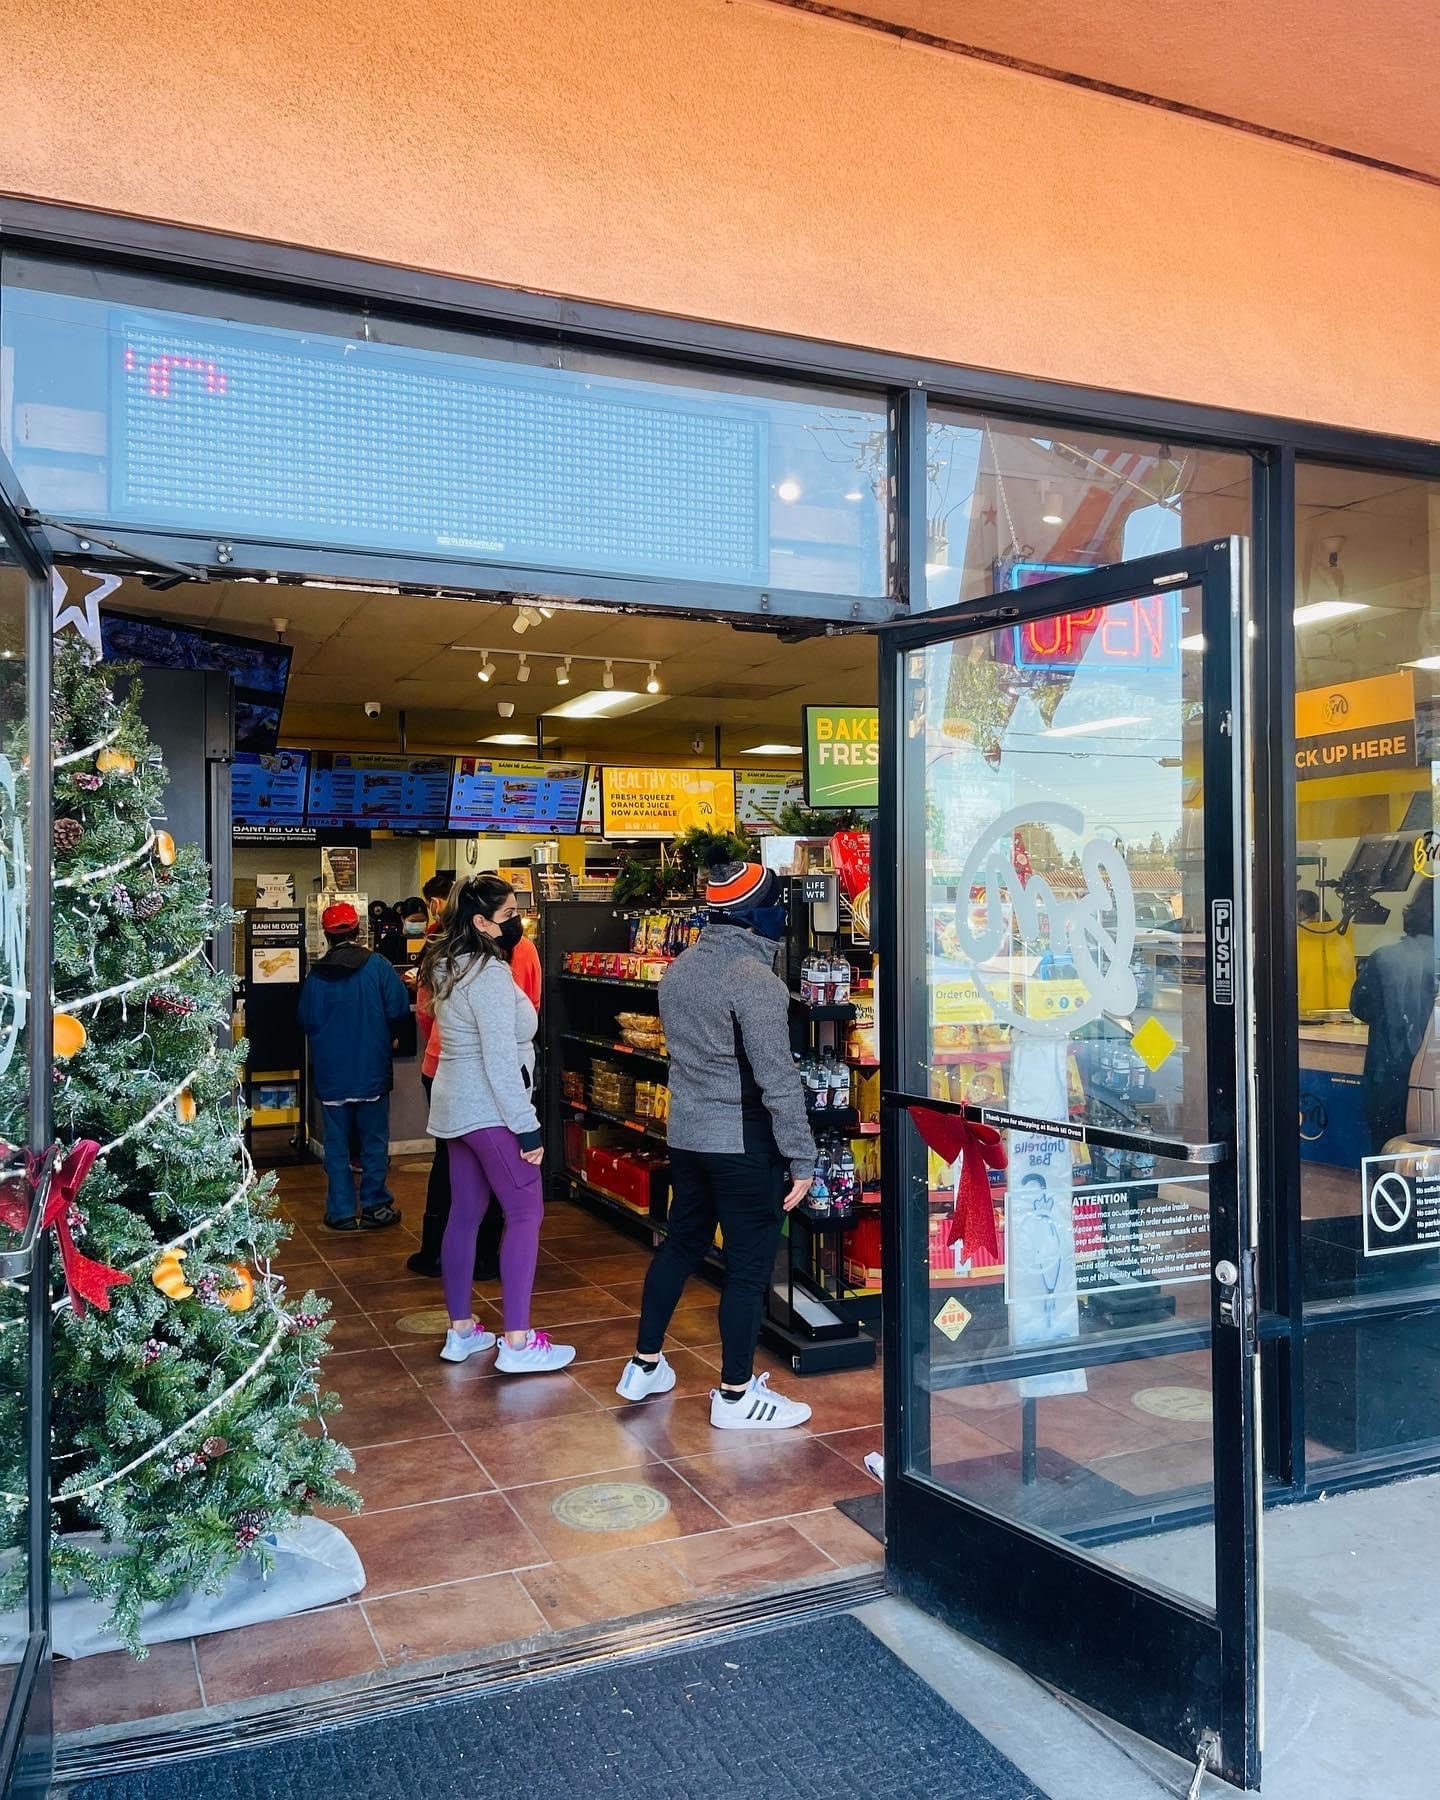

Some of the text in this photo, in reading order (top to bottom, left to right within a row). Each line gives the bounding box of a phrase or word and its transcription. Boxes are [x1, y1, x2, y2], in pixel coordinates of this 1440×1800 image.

[1029, 594, 1164, 657] OPEN
[819, 743, 879, 765] FRES
[1322, 745, 1348, 764] UP
[1352, 736, 1407, 760] HERE
[609, 771, 690, 789] HEALTHY SIP
[806, 881, 825, 889] LIFE
[806, 891, 825, 899] WTR
[1216, 909, 1230, 979] PUSH
[936, 990, 963, 999] Order
[985, 1113, 1000, 1121] Thank
[1018, 1119, 1040, 1130] shopping
[1067, 1128, 1082, 1137] Oven
[1415, 1161, 1429, 1170] NO
[1073, 1193, 1127, 1206] ATTENTION
[1072, 1211, 1097, 1220] reduced
[1098, 1210, 1110, 1218] max
[1146, 1205, 1151, 1213] 4
[1152, 1203, 1171, 1214] people
[1172, 1202, 1189, 1211] inside
[1417, 1209, 1424, 1217] No
[1093, 1222, 1107, 1230] wait
[1117, 1218, 1145, 1228] sandwich
[1146, 1217, 1162, 1226] order
[1162, 1214, 1185, 1224] outside
[1186, 1213, 1193, 1222] of
[1193, 1212, 1203, 1220] the
[1088, 1234, 1107, 1244] social
[1109, 1232, 1143, 1243] distancing
[1144, 1229, 1156, 1238] and
[1156, 1229, 1172, 1237] wear
[1173, 1226, 1190, 1235] mask
[1191, 1225, 1198, 1233] at
[1198, 1224, 1206, 1232] all
[1074, 1249, 1096, 1259] duced
[1113, 1245, 1130, 1254] hours
[1131, 1242, 1160, 1252] 5am-7pm
[1073, 1261, 1093, 1270] mited
[1094, 1258, 1109, 1268] staff
[1109, 1256, 1140, 1266] available,
[1140, 1255, 1154, 1264] sorry
[1155, 1253, 1164, 1262] for
[1164, 1253, 1175, 1262] any
[1074, 1274, 1089, 1284] reas
[1089, 1272, 1097, 1282] of
[1097, 1270, 1109, 1280] this
[1109, 1269, 1131, 1280] facility
[1131, 1267, 1143, 1276] will
[1143, 1267, 1151, 1275] be
[1152, 1263, 1184, 1274] monitored
[1185, 1261, 1198, 1270] and
